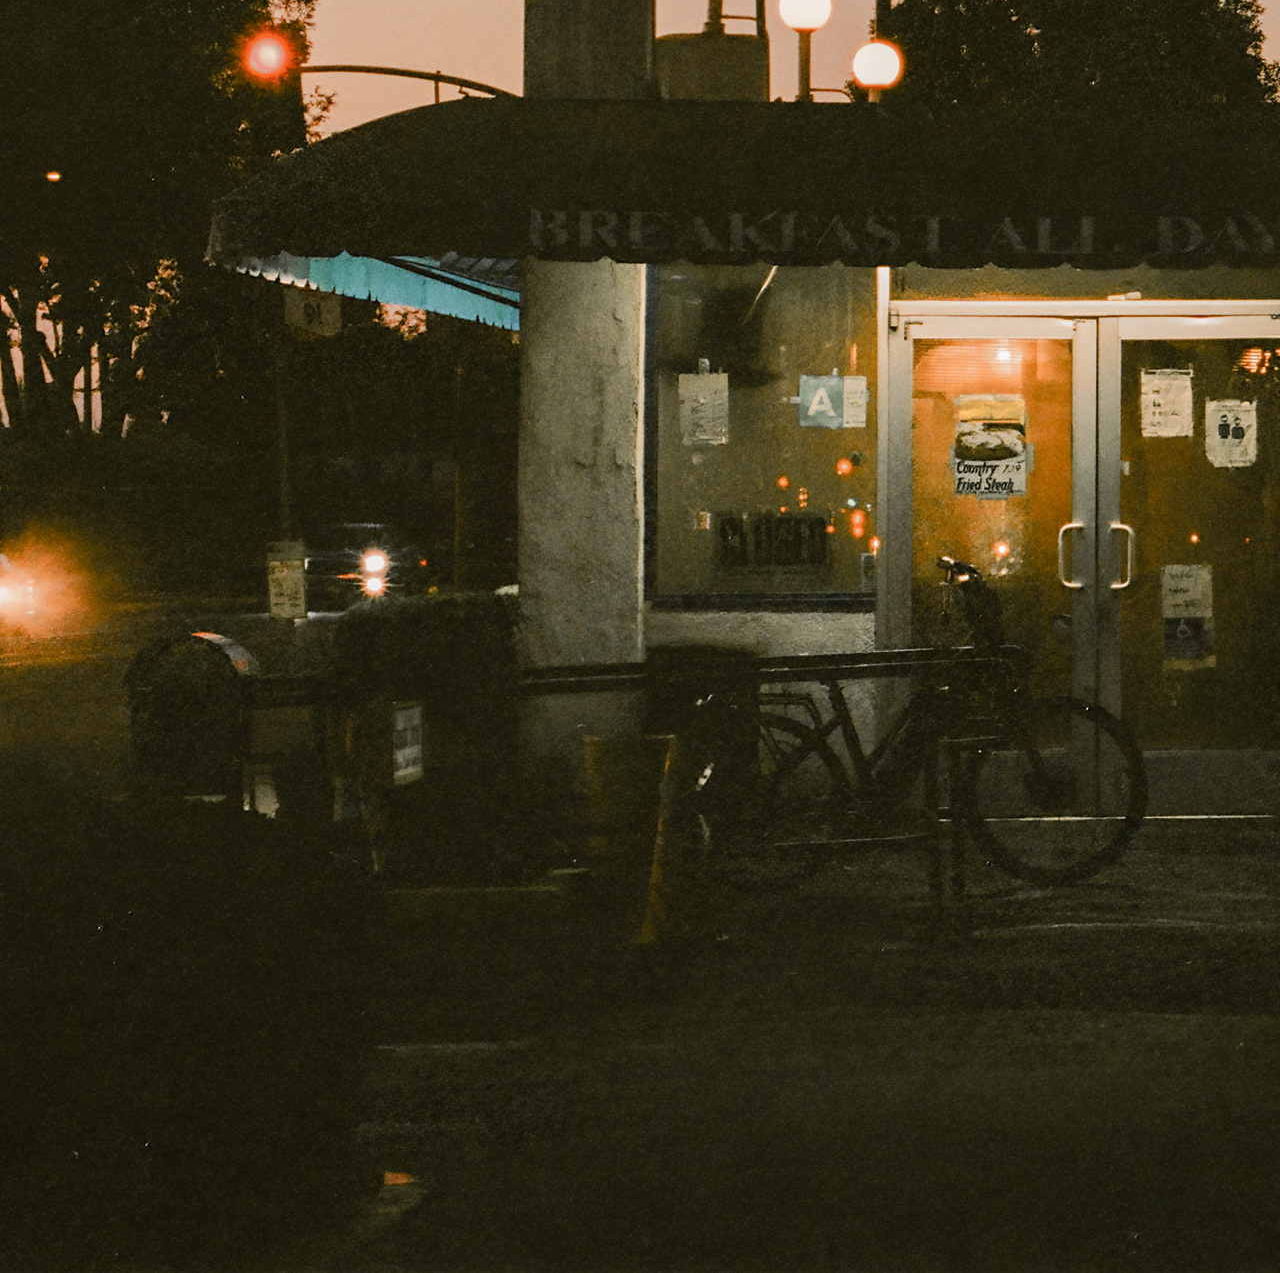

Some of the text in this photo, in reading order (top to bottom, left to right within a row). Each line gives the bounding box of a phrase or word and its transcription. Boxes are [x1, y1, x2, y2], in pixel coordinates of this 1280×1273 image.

[530, 207, 956, 254] BREAKFAST
[988, 215, 1123, 255] ALL
[807, 387, 836, 417] A
[956, 461, 1000, 477] Country
[956, 477, 1014, 492] Fried Steak
